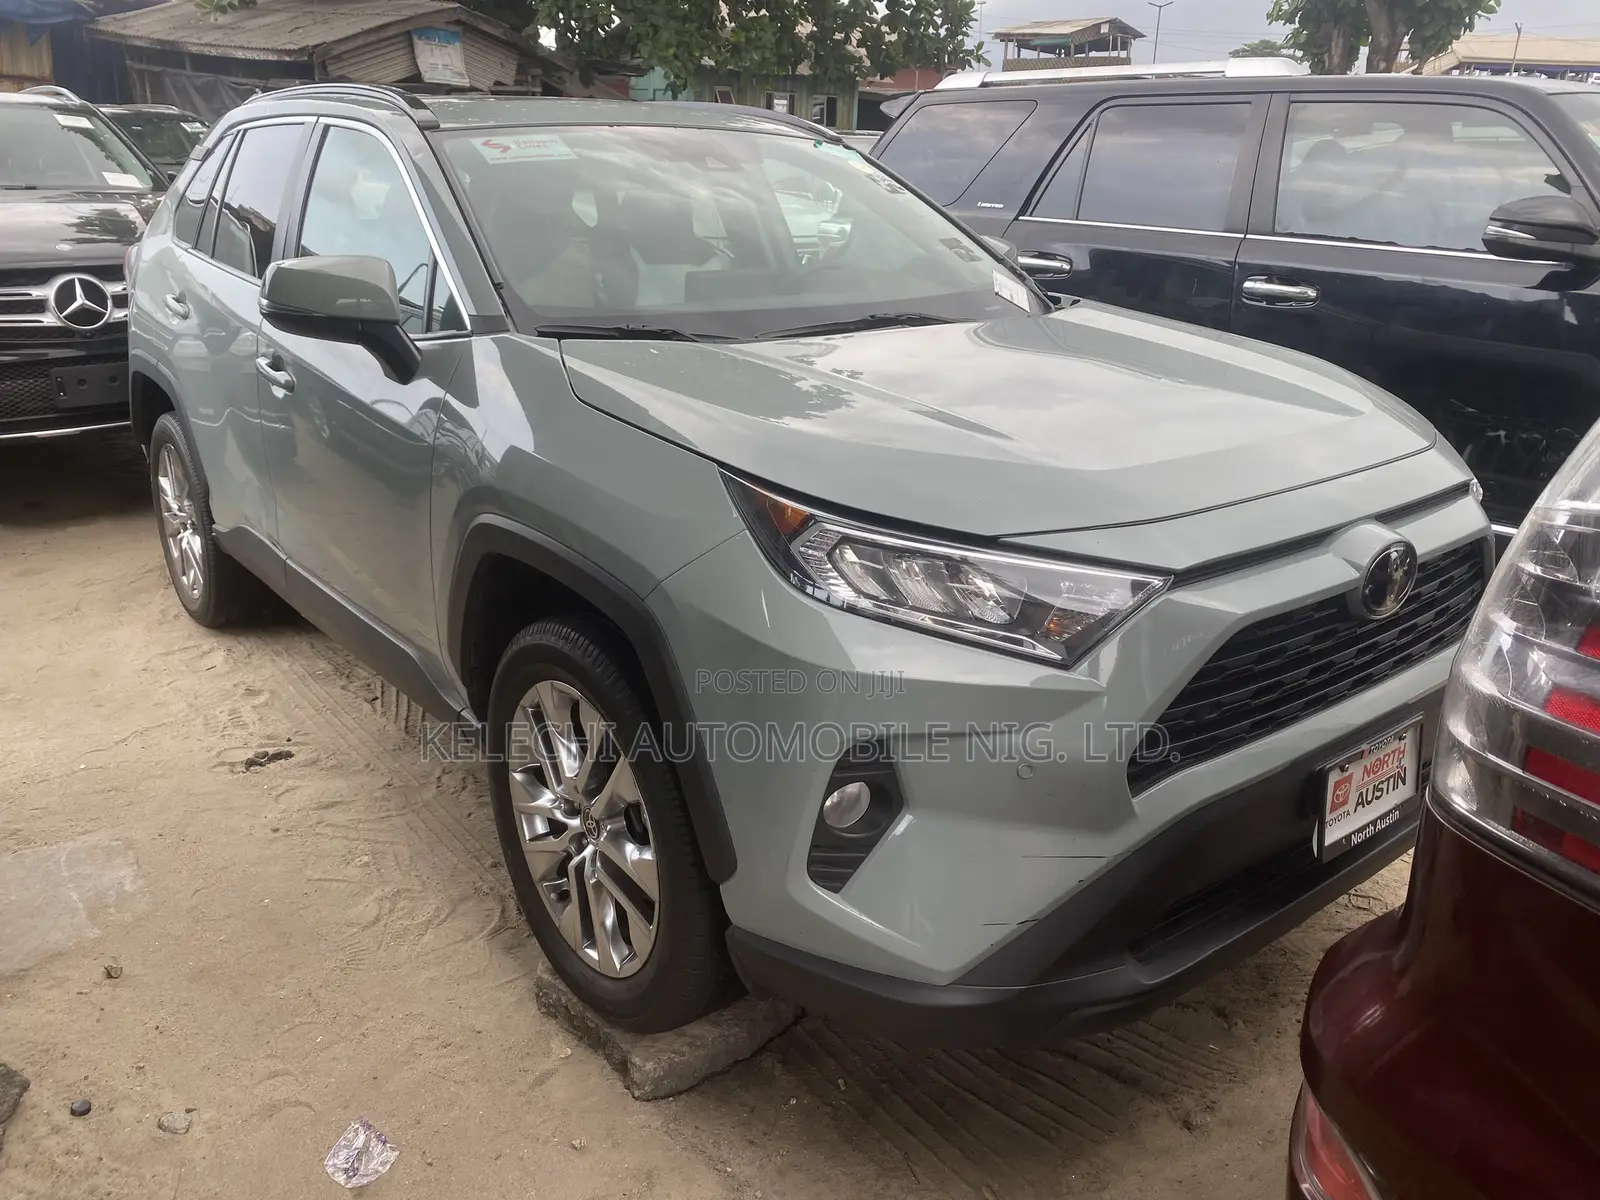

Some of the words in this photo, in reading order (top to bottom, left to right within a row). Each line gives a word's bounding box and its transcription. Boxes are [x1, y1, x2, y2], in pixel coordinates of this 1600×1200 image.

[1362, 742, 1407, 782] NORTH
[1353, 766, 1407, 813] AUSTIN
[1325, 809, 1351, 829] TOYOTA
[1351, 824, 1375, 847] North
[1376, 809, 1400, 832] Austin
